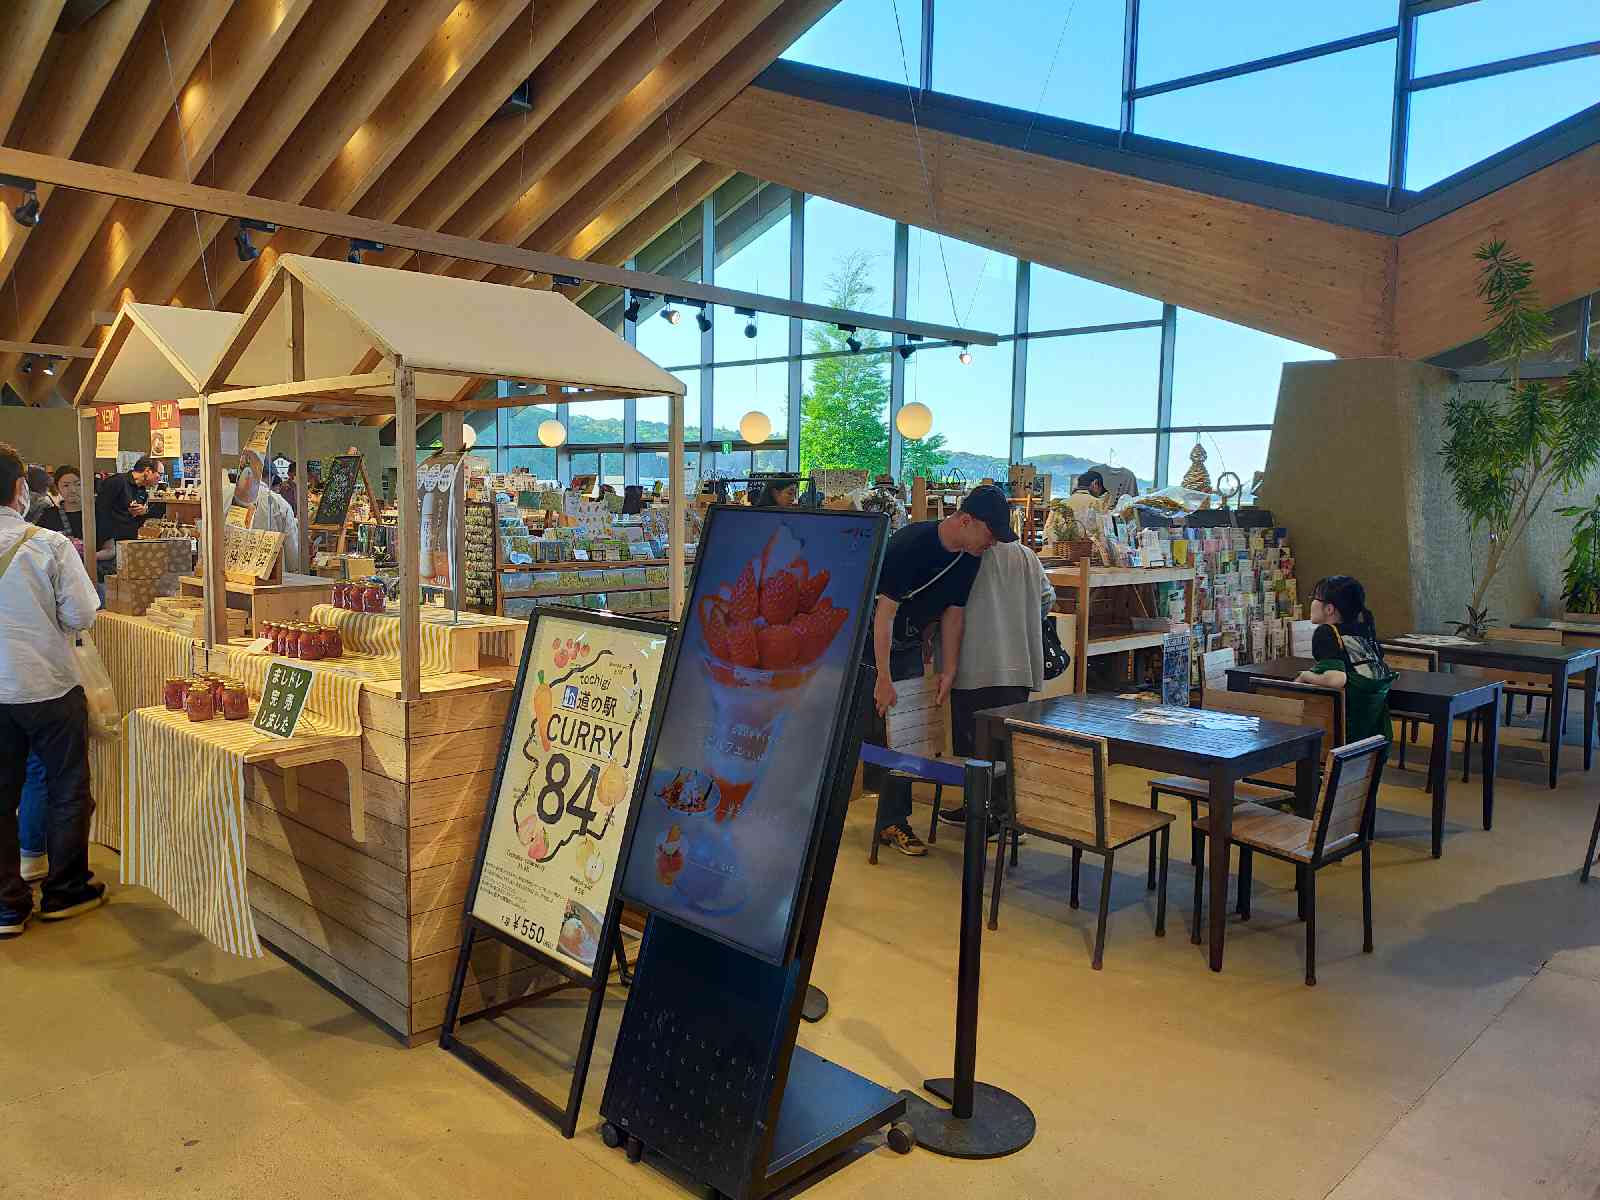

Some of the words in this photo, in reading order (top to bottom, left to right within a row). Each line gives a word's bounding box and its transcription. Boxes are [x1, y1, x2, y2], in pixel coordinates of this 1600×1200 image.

[576, 688, 618, 717] 道の駅
[259, 710, 289, 733] しました
[547, 713, 622, 758] CURRY
[537, 752, 600, 835] 84
[512, 913, 545, 944] ¥550
